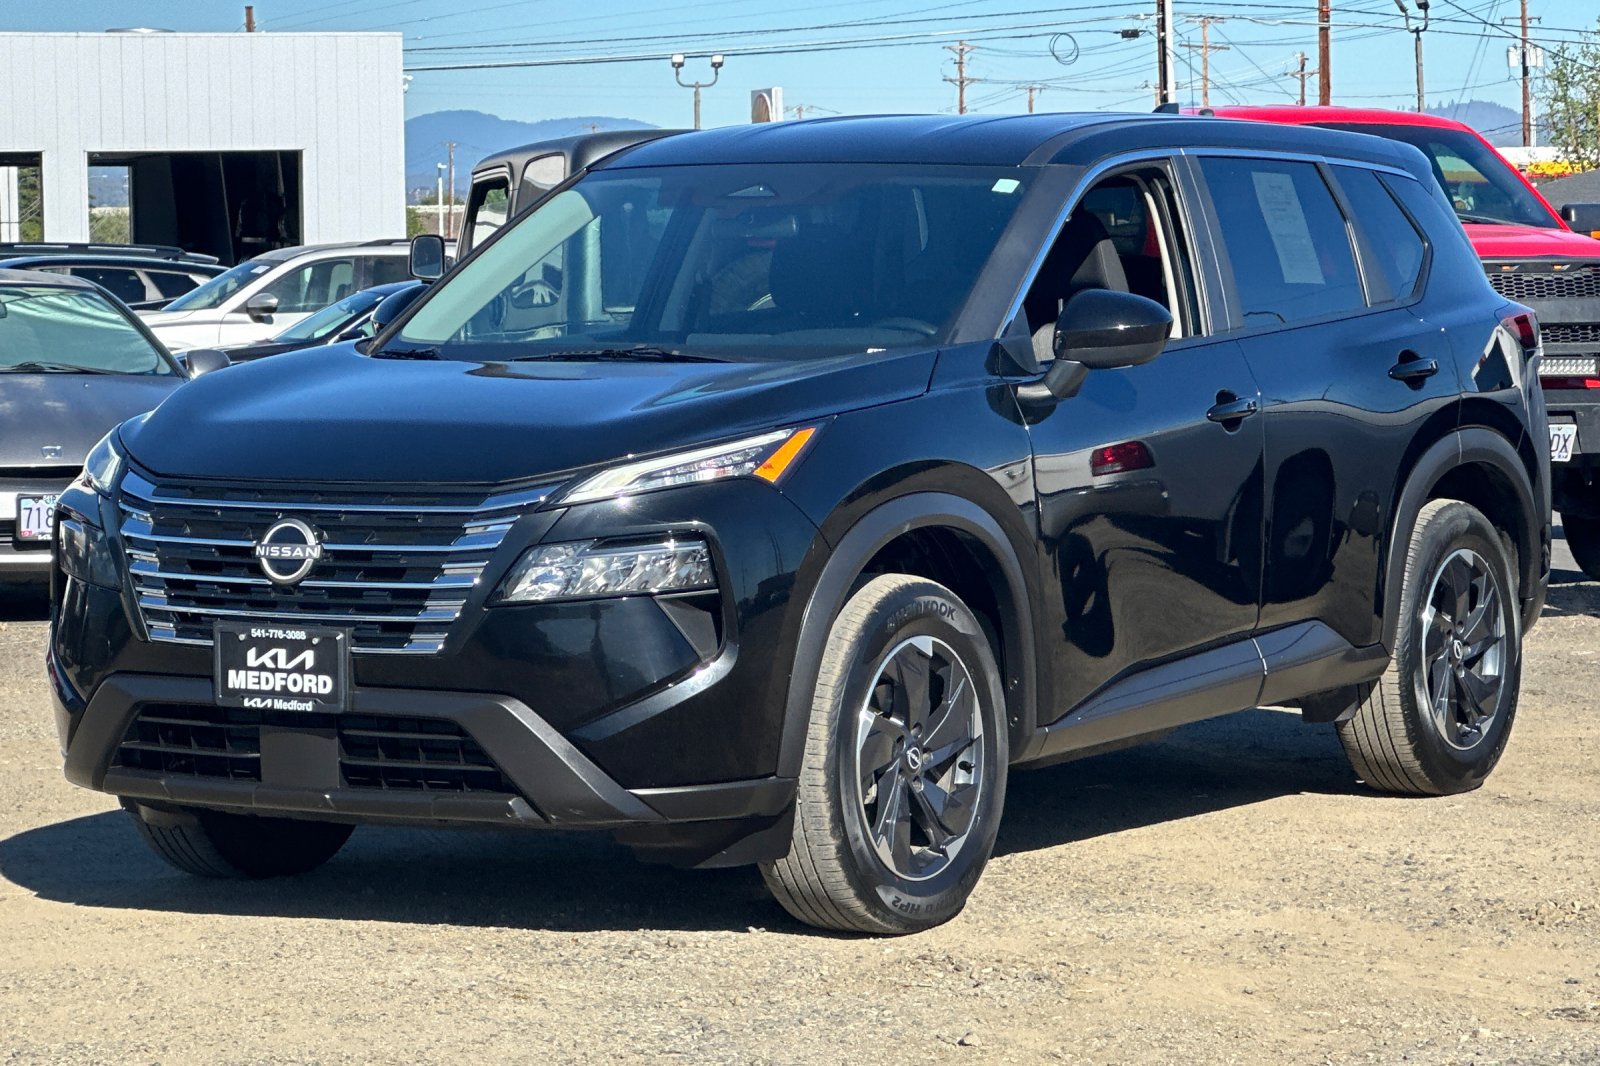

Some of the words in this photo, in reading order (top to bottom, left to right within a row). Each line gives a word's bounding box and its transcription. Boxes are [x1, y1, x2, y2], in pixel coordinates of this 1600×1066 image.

[23, 507, 53, 529] 718
[256, 546, 319, 558] NISSAN
[246, 646, 314, 669] KIA
[227, 669, 333, 694] MEDFORD
[243, 697, 272, 708] KIA
[273, 699, 313, 711] Medford
